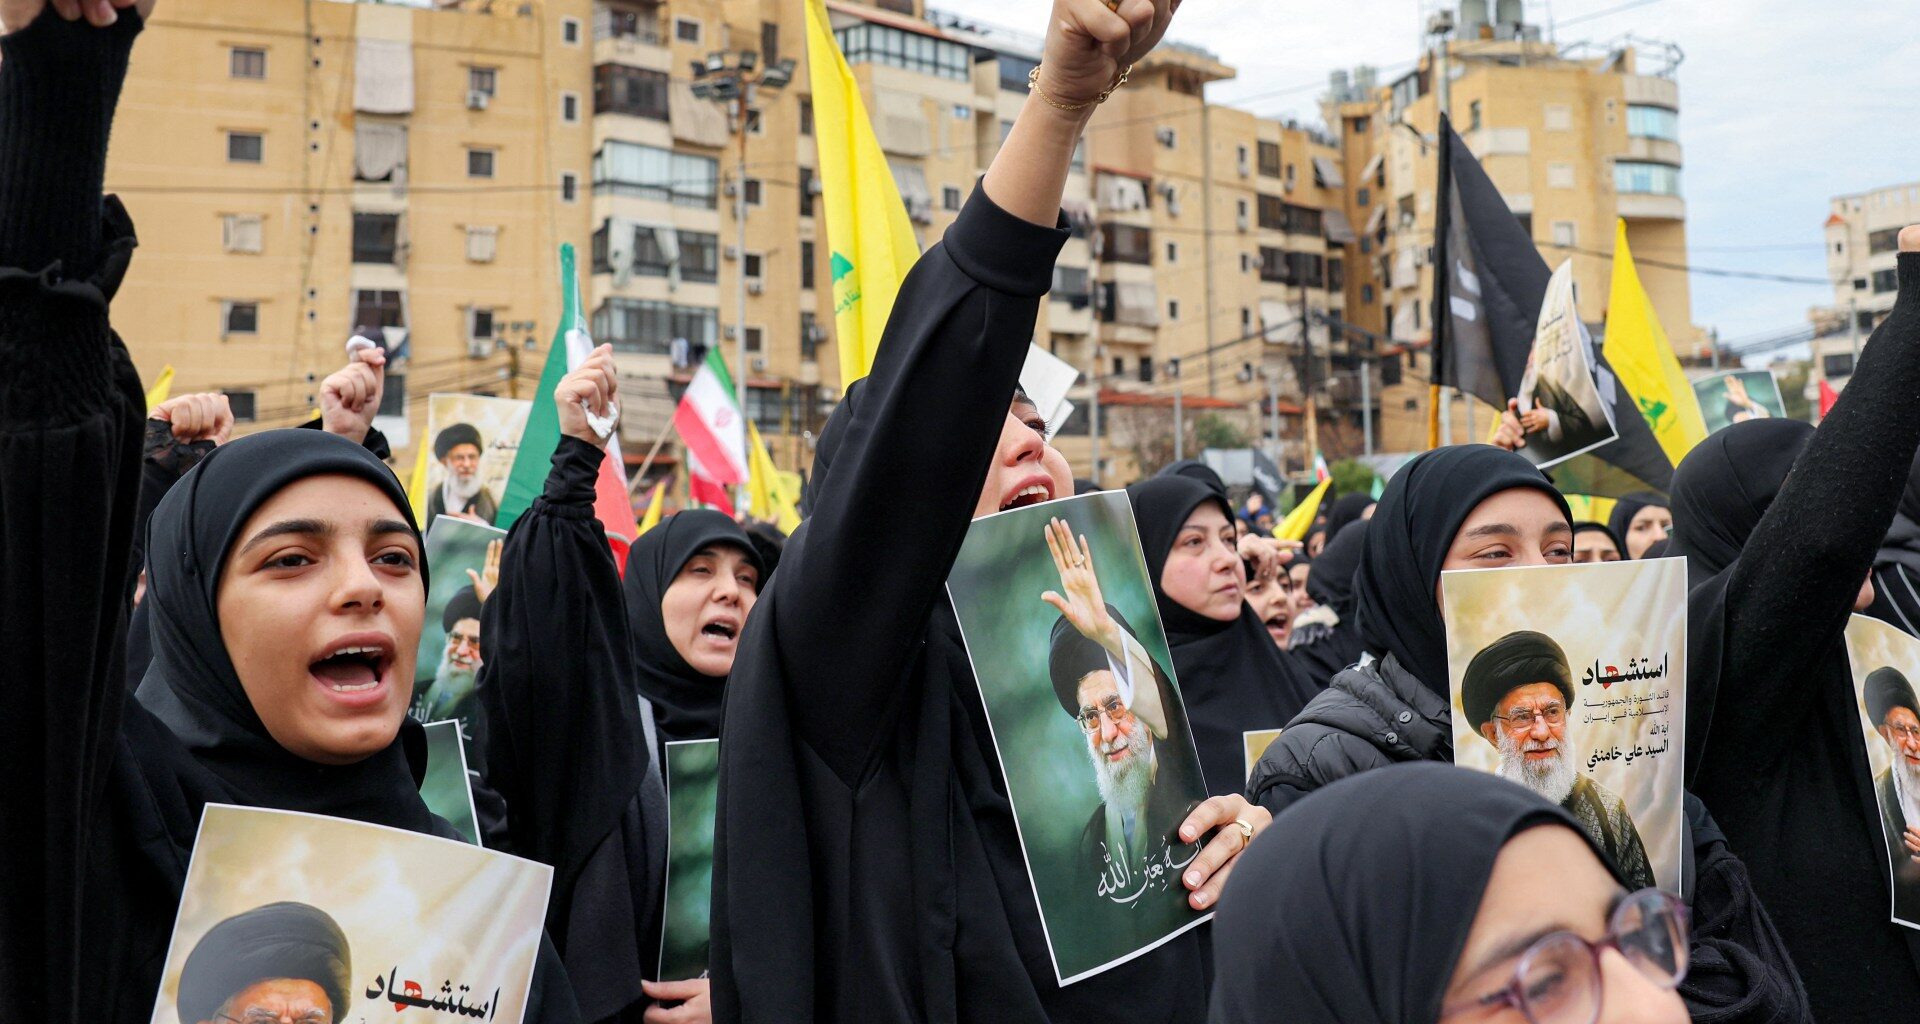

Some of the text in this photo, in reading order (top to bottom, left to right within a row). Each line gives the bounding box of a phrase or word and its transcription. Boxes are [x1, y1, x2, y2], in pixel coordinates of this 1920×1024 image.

[1582, 651, 1668, 690] استشهاد
[1634, 692, 1656, 705] الثورة
[1656, 689, 1670, 700] قائد
[1611, 708, 1627, 724] في
[1586, 738, 1669, 773] السيد علي خامنئي
[365, 965, 501, 1023] استشهاد
